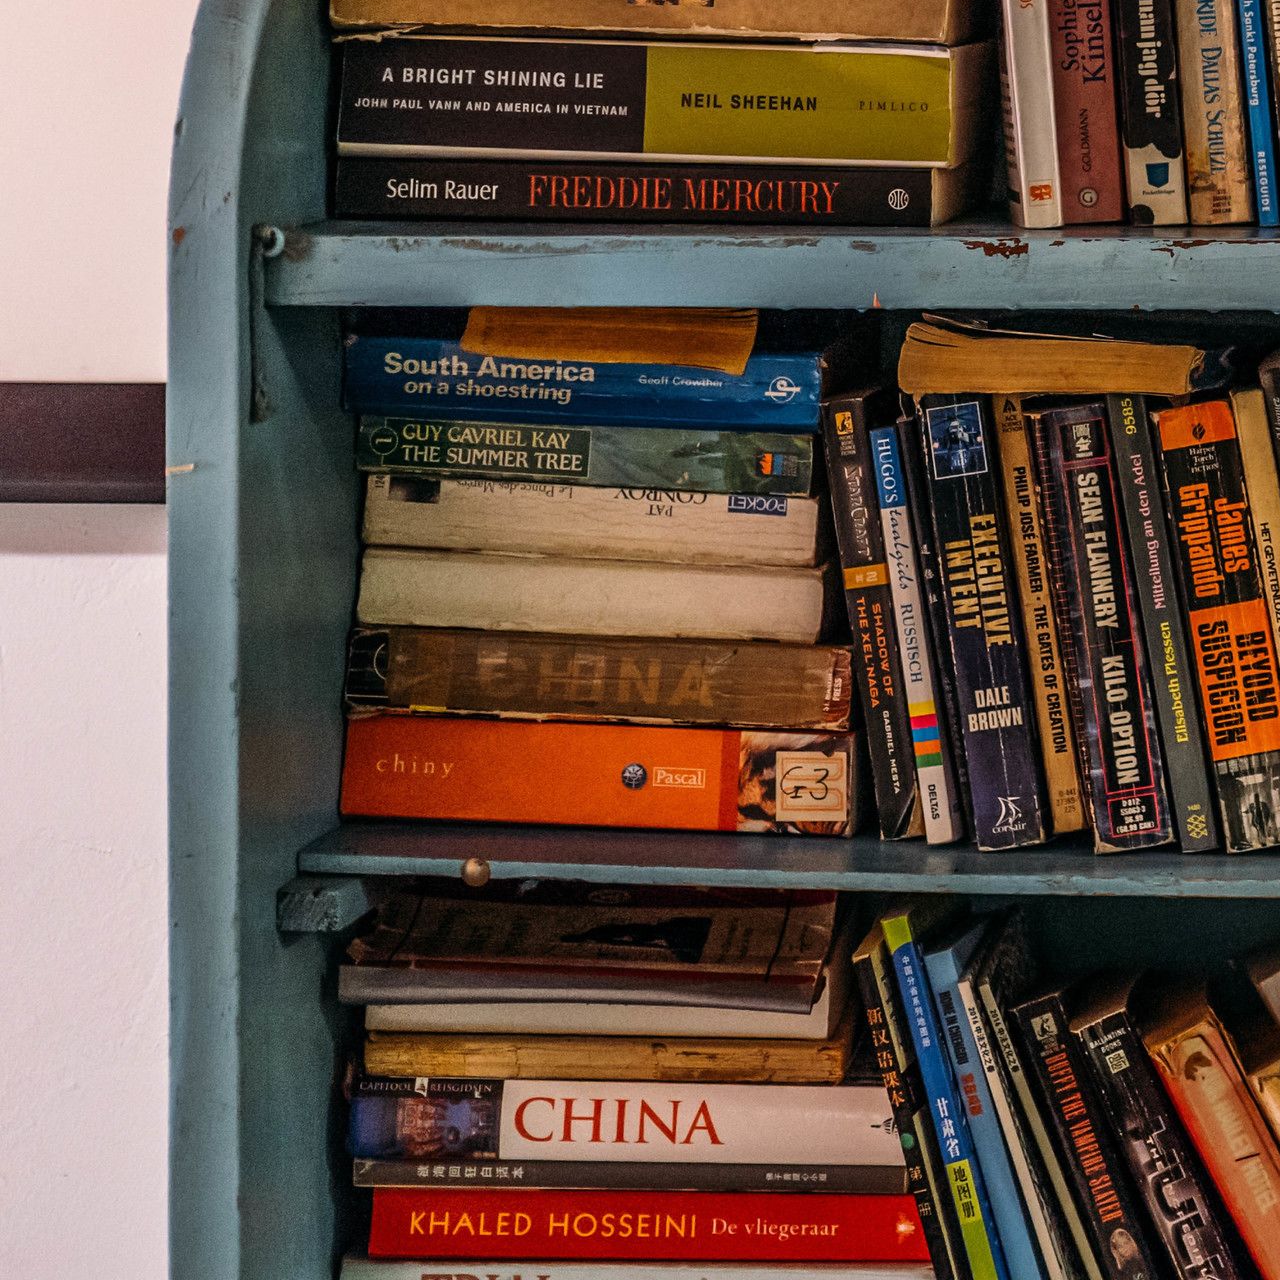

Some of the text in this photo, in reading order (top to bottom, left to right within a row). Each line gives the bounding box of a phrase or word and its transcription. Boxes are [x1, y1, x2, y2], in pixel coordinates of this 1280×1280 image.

[1241, 10, 1256, 42] Sankt
[383, 66, 605, 89] A BRIGHT SHINING LIE
[1244, 44, 1262, 106] Petersburg
[354, 97, 630, 116] JOHN PAUL VANN AND AMERICA IN VIETNAM
[681, 91, 819, 112] NEIL SHEEHAN
[860, 100, 931, 113] PIMLICO
[386, 174, 841, 214] Selim Rauer FREDDIE MERCURY
[1257, 151, 1270, 212] RESEGUIDE
[383, 352, 596, 383] South America
[403, 380, 572, 404] on a shoestring
[401, 425, 571, 450] GUY GAVRIEL KAY
[401, 445, 583, 472] THE SUMMER TREE
[1177, 482, 1223, 598] Grippando
[1213, 497, 1252, 573] James
[944, 539, 982, 629] INTENT
[980, 513, 1013, 647] EXECUTIVE
[1077, 472, 1140, 784] SEAN FLANNERY KILO OPTION
[1195, 620, 1247, 747] SUSPICION
[1235, 630, 1279, 722] BEYOND
[974, 689, 1010, 708] DALE
[967, 707, 1023, 732] BROWN
[375, 756, 456, 779] chiny
[655, 770, 705, 786] Pascal
[514, 1097, 724, 1146] CHINA
[1045, 1054, 1124, 1224] BUFFY THE VAMPIRE SLAYER
[408, 1209, 840, 1240] KHALED HOSSEINI De vliegeraar
